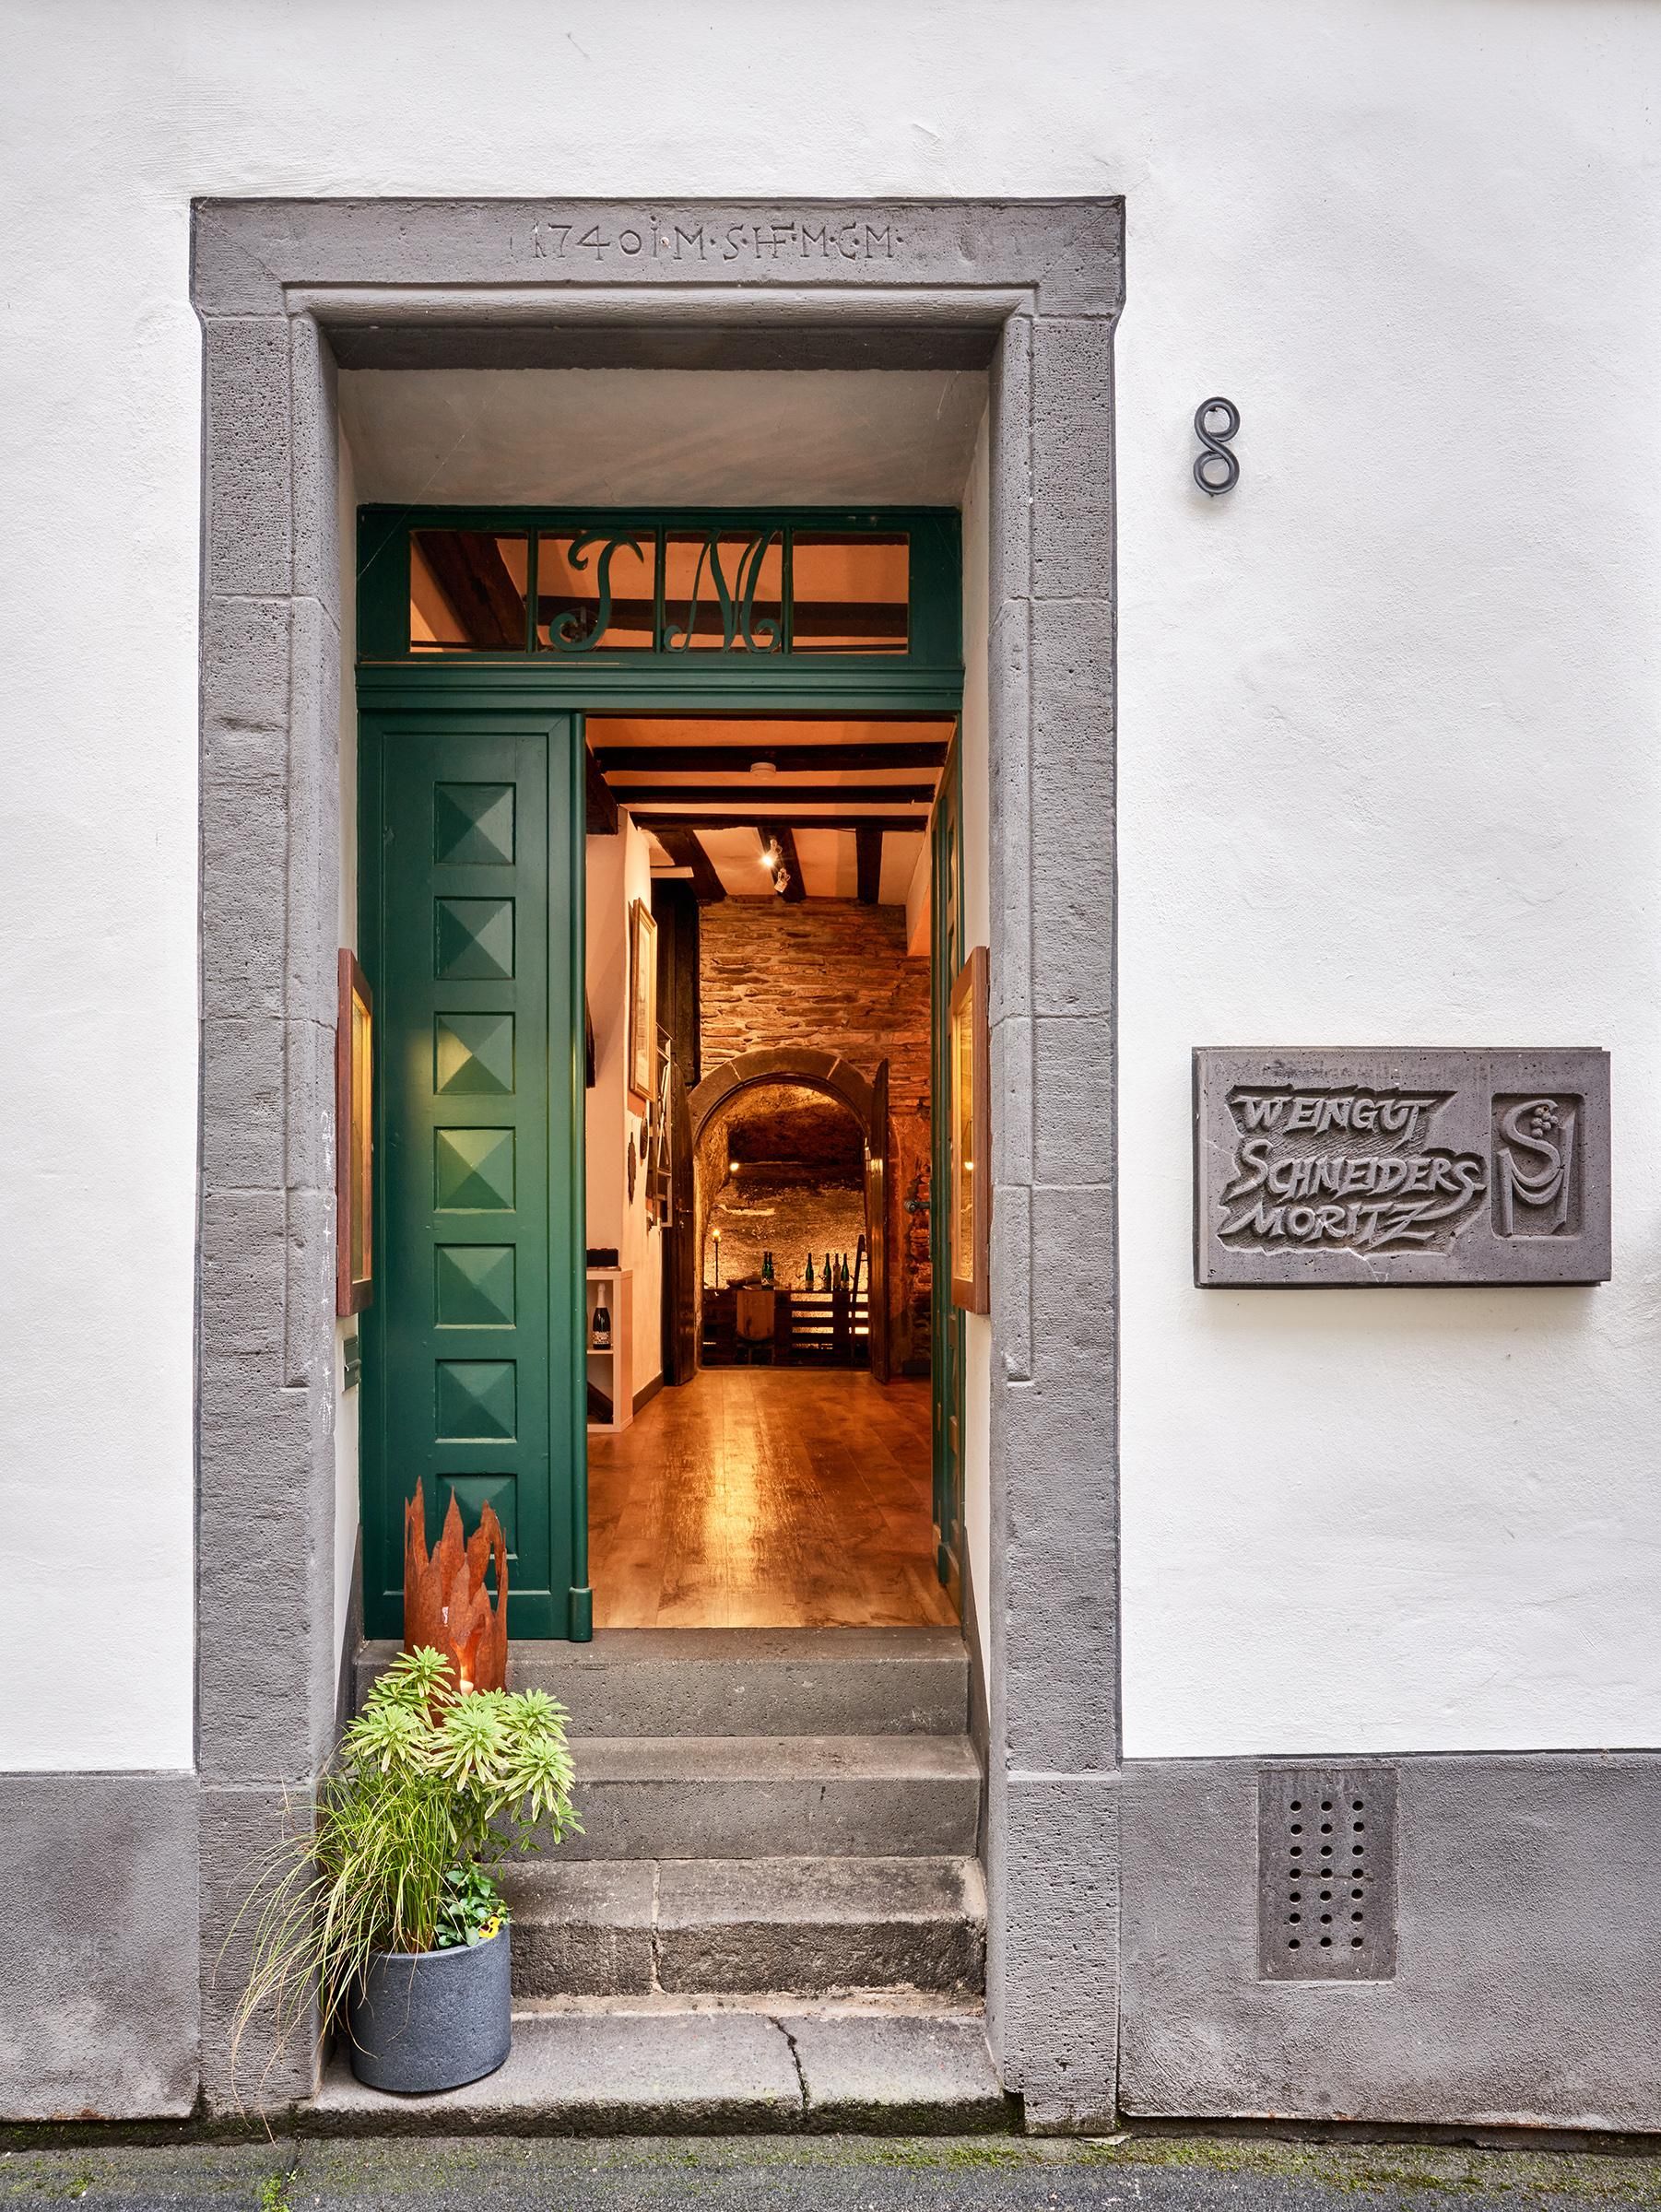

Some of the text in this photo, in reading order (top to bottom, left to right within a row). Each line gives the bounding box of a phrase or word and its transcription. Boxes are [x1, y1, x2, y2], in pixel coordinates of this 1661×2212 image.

[1193, 395, 1241, 496] 8
[1230, 1095, 1436, 1152] WEINGUT
[1219, 1137, 1487, 1222] SCHNEIDERS
[1217, 1199, 1436, 1252] MORITZ
